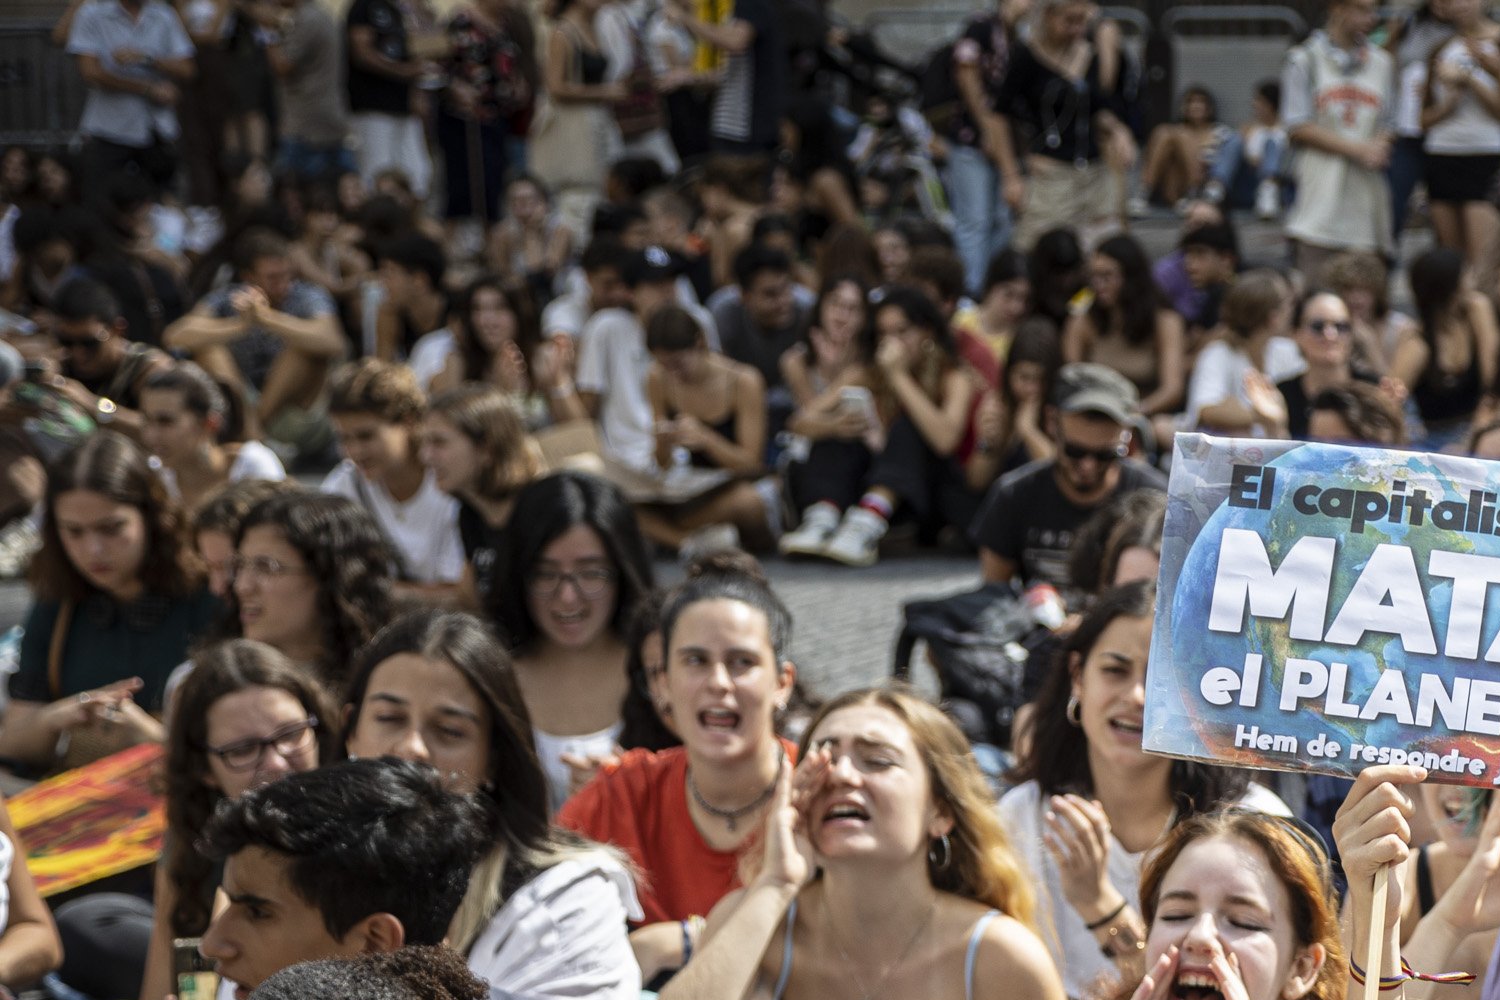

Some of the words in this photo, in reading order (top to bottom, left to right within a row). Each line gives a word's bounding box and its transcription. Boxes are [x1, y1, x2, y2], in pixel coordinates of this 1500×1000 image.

[1228, 464, 1276, 511] El
[1200, 652, 1263, 708] el
[1234, 724, 1297, 754] Hem
[1306, 733, 1342, 759] de
[1349, 743, 1486, 776] respondre
